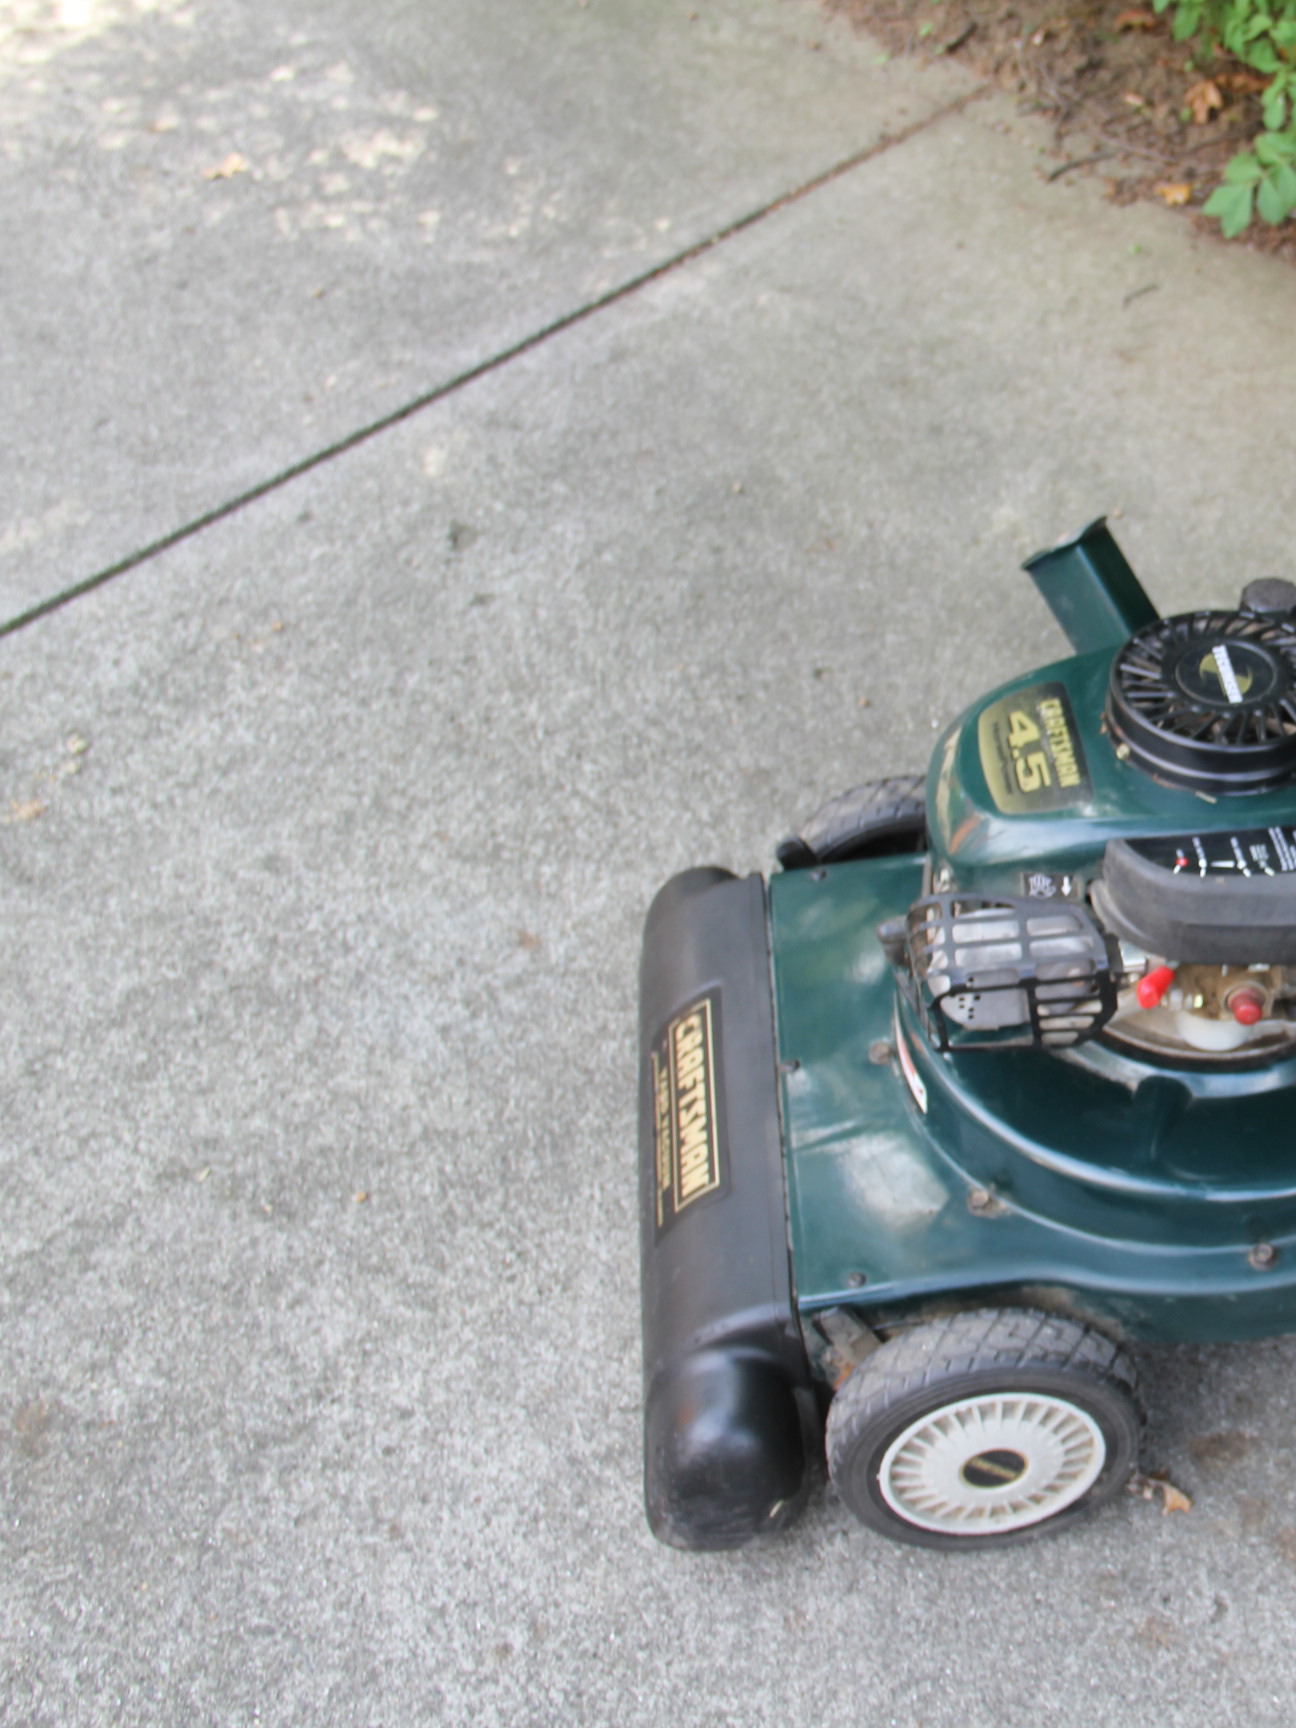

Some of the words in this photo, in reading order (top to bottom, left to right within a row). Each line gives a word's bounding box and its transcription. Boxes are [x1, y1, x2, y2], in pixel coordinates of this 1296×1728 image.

[1008, 709, 1051, 793] 4.5
[1040, 698, 1081, 788] CRAFTSMAN
[675, 1014, 710, 1198] CRAFTSMAN
